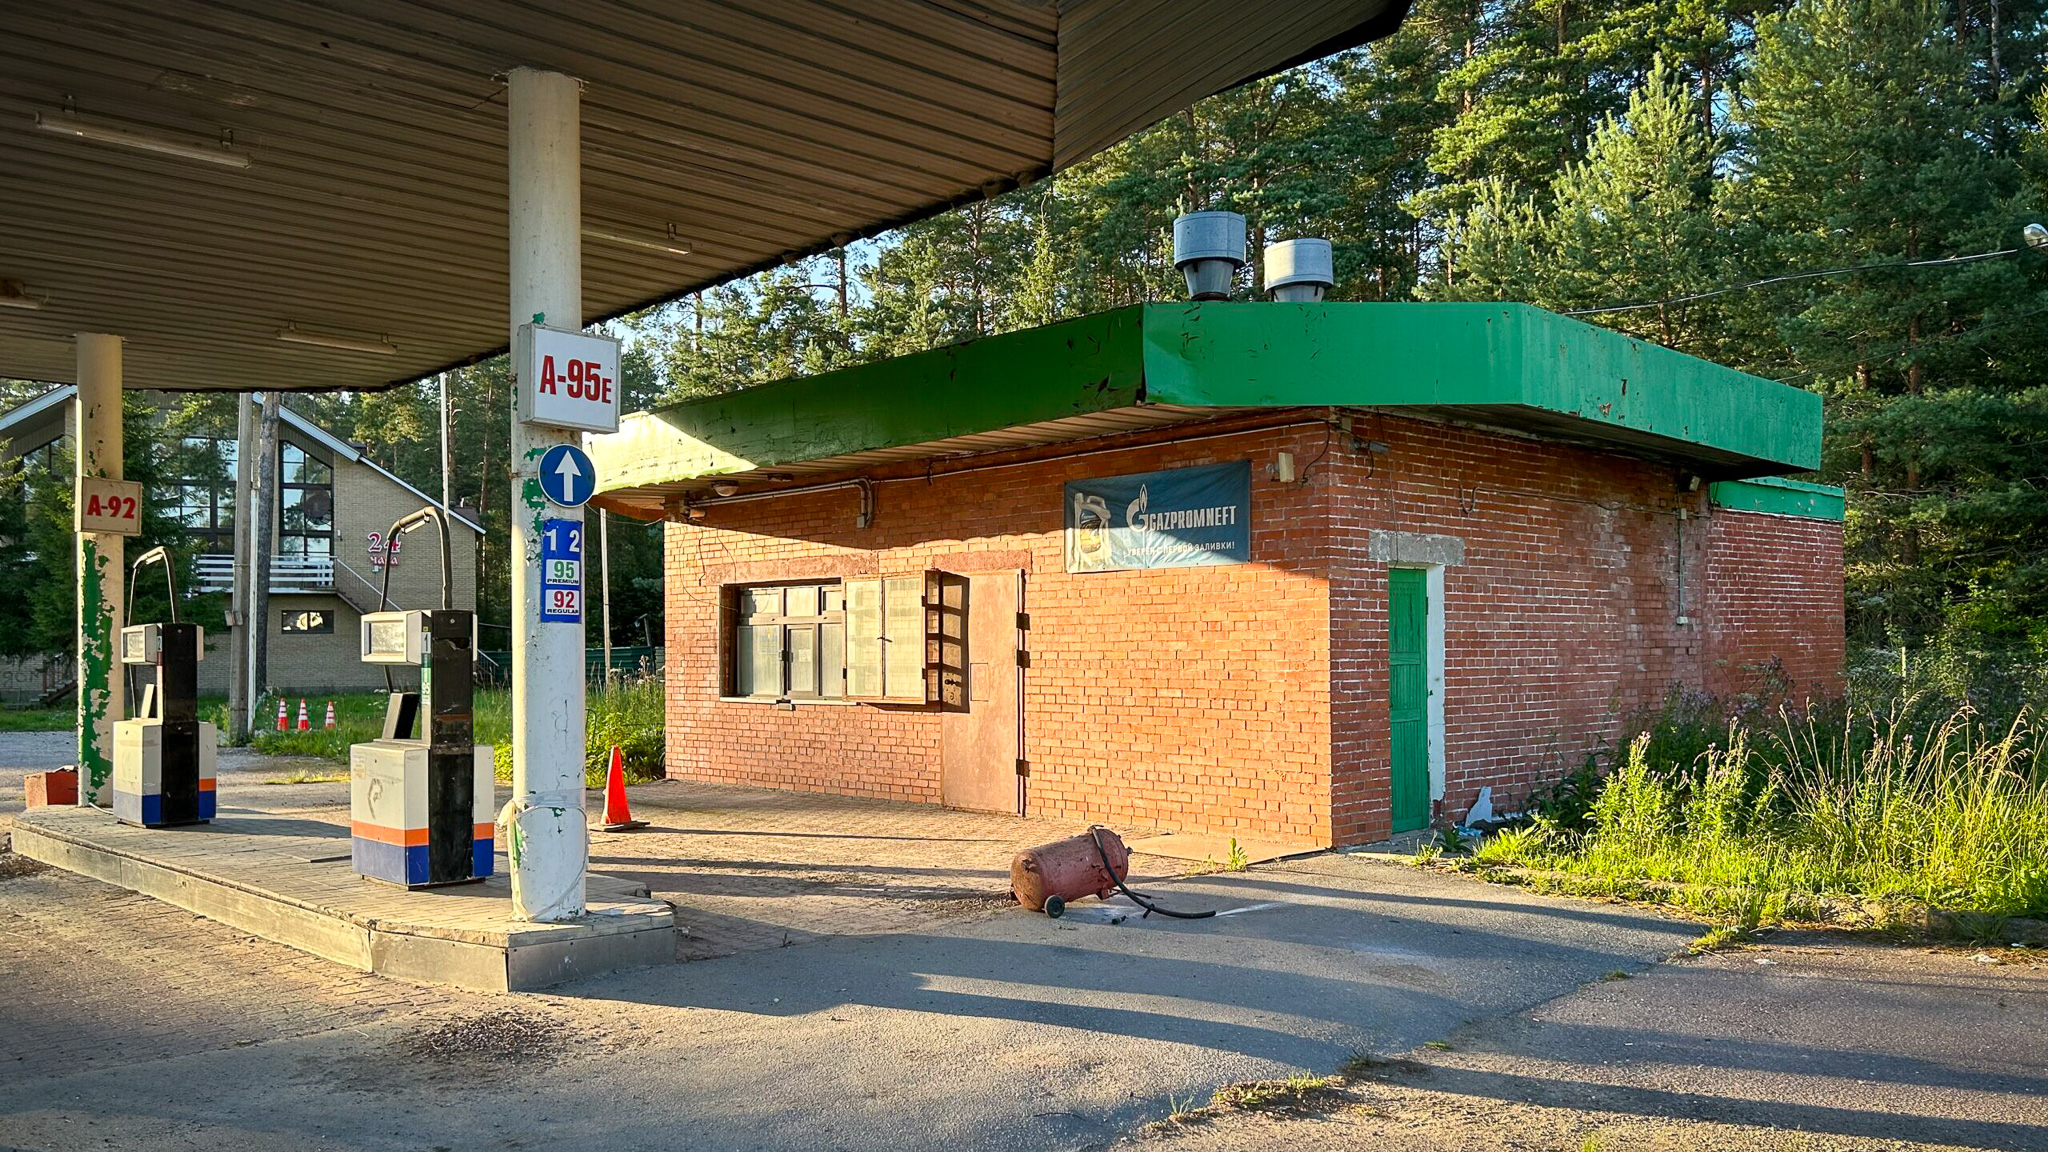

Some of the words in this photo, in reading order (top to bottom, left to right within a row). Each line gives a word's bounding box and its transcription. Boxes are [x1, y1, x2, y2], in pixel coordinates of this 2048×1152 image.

[87, 494, 136, 519] A-92
[1149, 505, 1237, 531] GAZPROMNEFT
[545, 528, 557, 551] 1
[569, 529, 580, 552] 2
[1164, 543, 1193, 554] ПЕРВОЙ
[1195, 541, 1235, 551] ЗАЛИВКИ!
[370, 556, 398, 565] чаа
[554, 561, 575, 579] 95
[553, 591, 575, 609] 92
